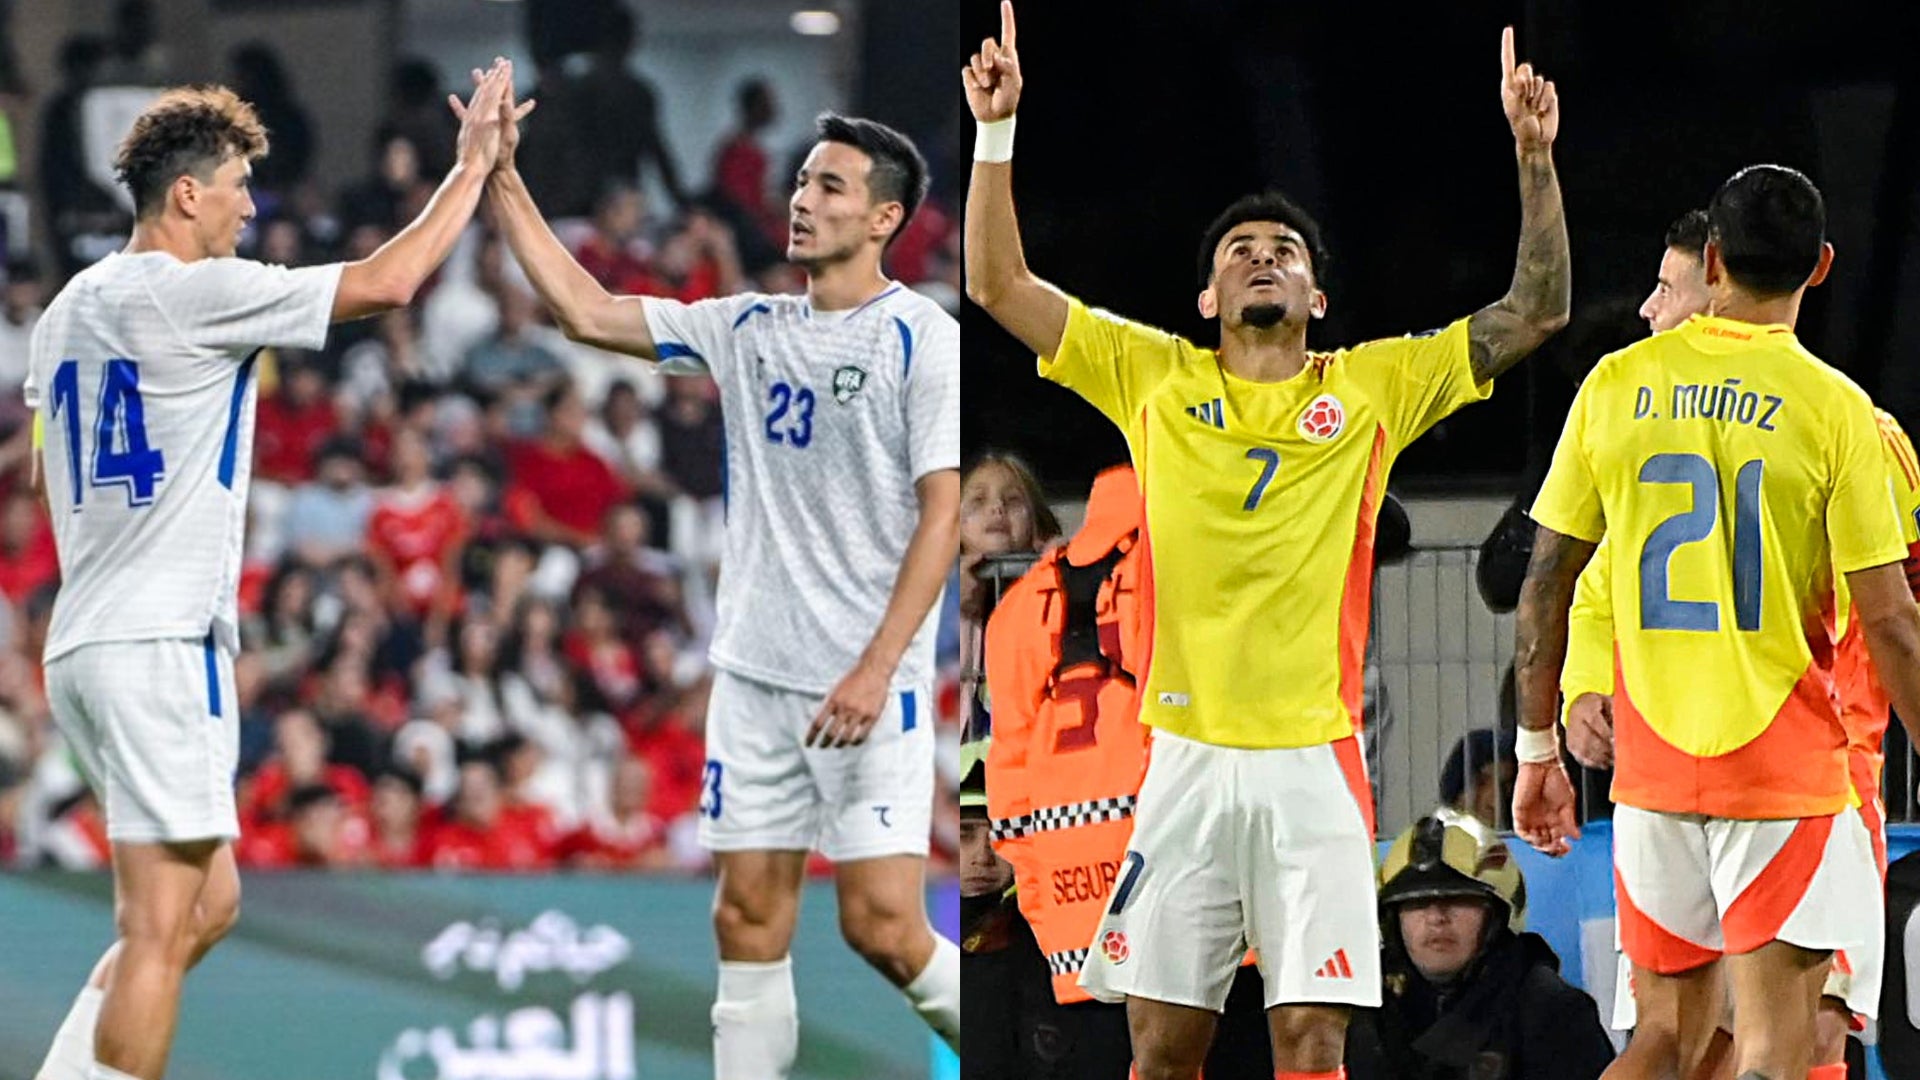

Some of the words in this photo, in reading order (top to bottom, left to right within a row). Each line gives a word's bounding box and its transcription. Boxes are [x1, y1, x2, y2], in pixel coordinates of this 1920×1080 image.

[49, 358, 165, 513] 14
[765, 382, 815, 448] 23
[1634, 386, 1659, 420] D.
[1672, 378, 1783, 432] MUÑOZ
[1243, 447, 1281, 512] 7
[1638, 453, 1764, 633] 21
